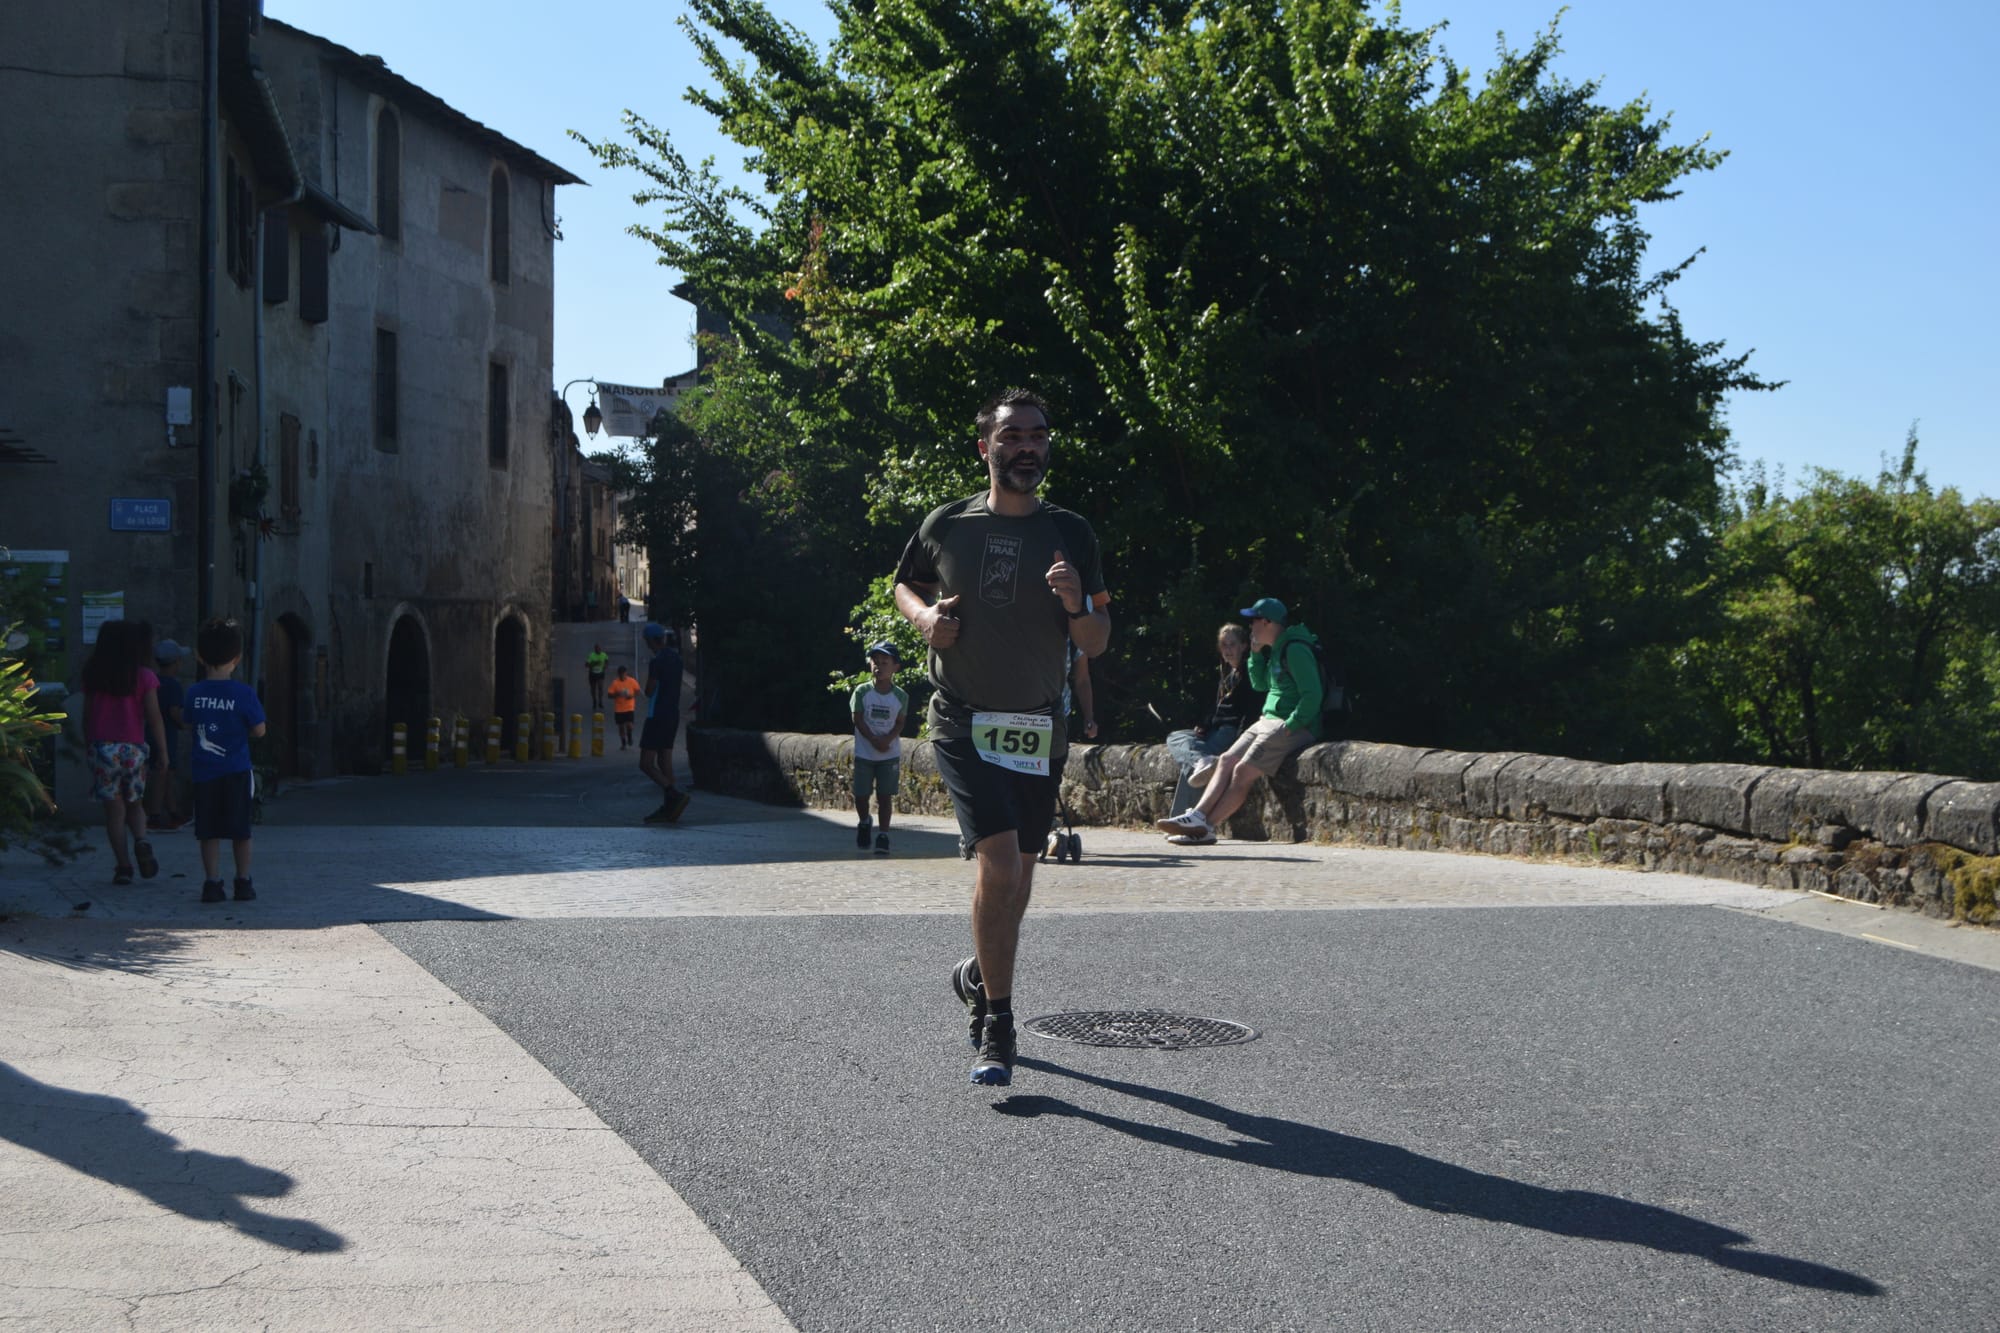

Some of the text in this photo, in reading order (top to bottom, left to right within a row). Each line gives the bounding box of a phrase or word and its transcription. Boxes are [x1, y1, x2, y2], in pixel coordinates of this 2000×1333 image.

[602, 384, 653, 397] MAISON
[657, 386, 674, 397] DE
[134, 504, 157, 513] PLACE
[989, 545, 1017, 556] TRAIL
[194, 697, 235, 711] ETHAN
[984, 727, 1040, 755] 159
